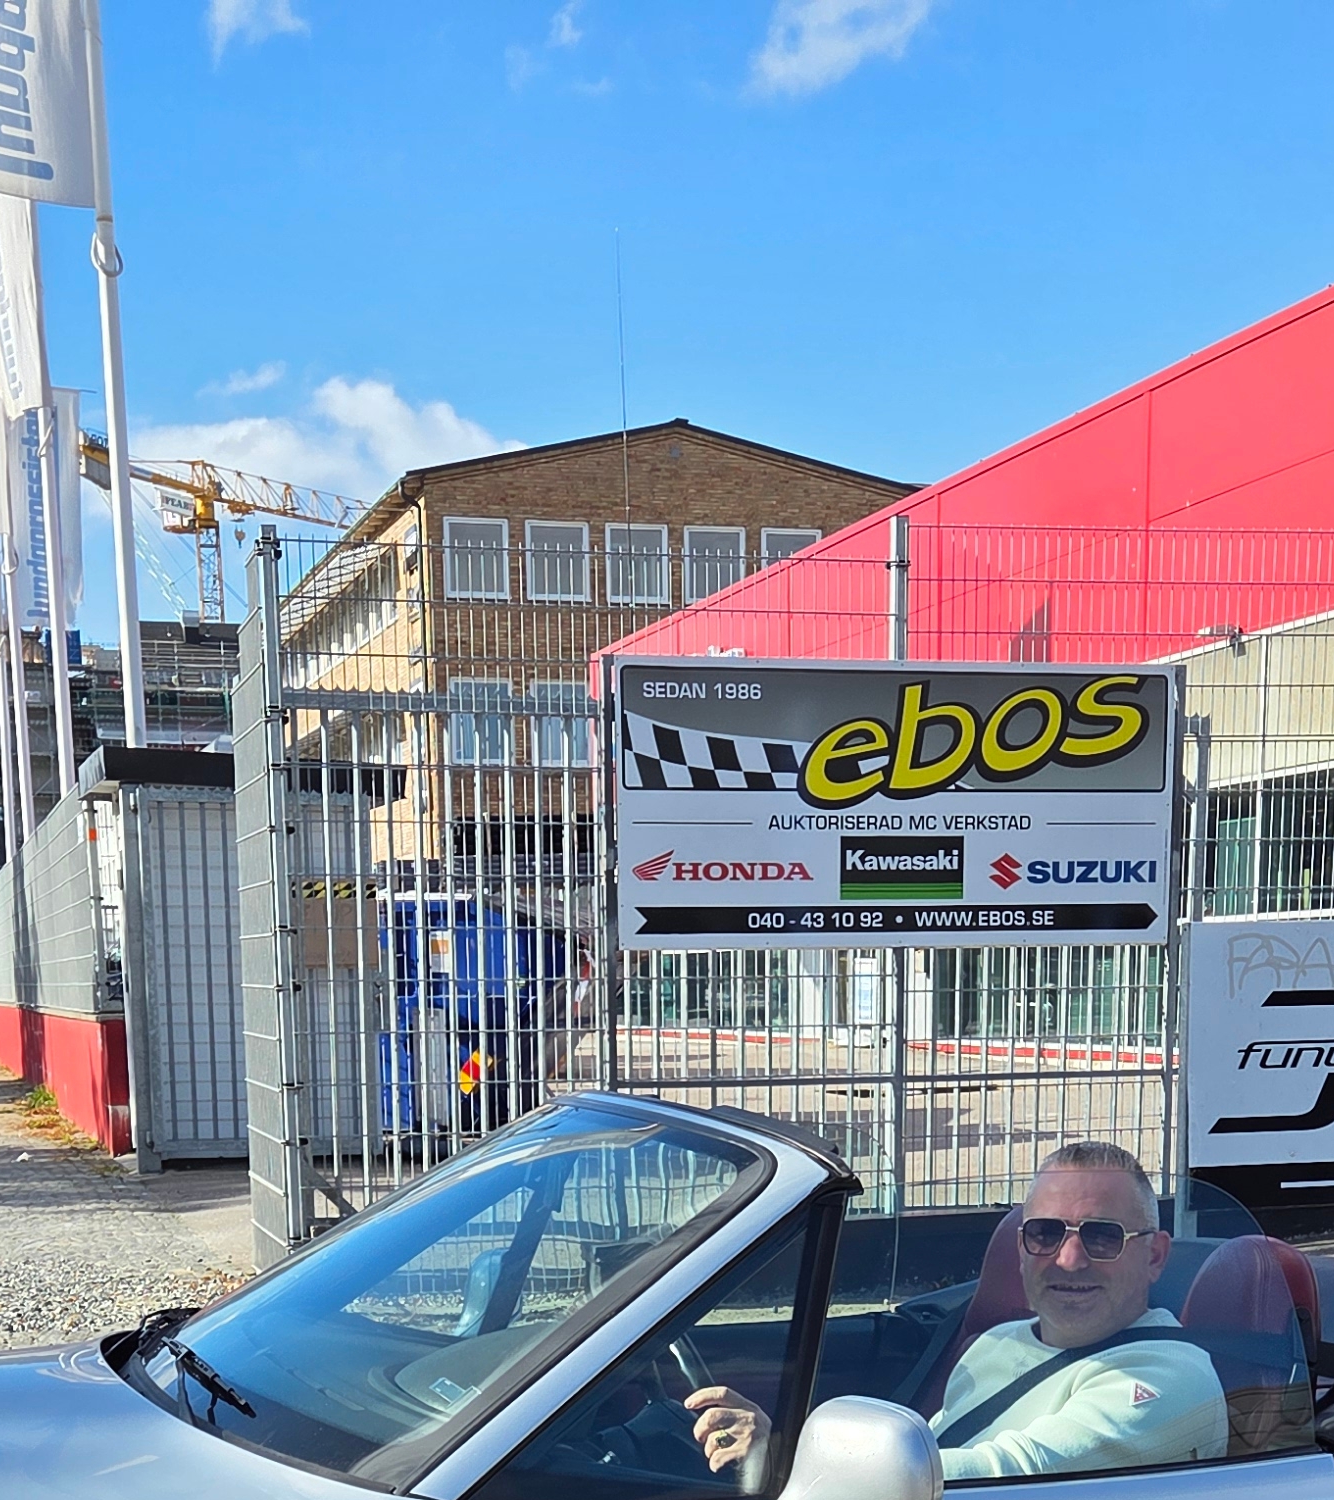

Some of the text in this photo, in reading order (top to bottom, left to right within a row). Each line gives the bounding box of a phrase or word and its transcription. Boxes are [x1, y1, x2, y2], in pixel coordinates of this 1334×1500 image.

[642, 681, 762, 700] SEDAN 1986
[803, 675, 1145, 801] ebos
[768, 815, 1032, 831] AUKTORISERAD MC VERKSTAD
[672, 849, 1157, 884] HONDA Kawasaki SUZUKI
[747, 912, 785, 929] 040
[800, 912, 825, 928] 43
[831, 912, 855, 928] 10
[859, 911, 884, 928] 92
[914, 910, 1055, 927] WWW.EBOS.SE
